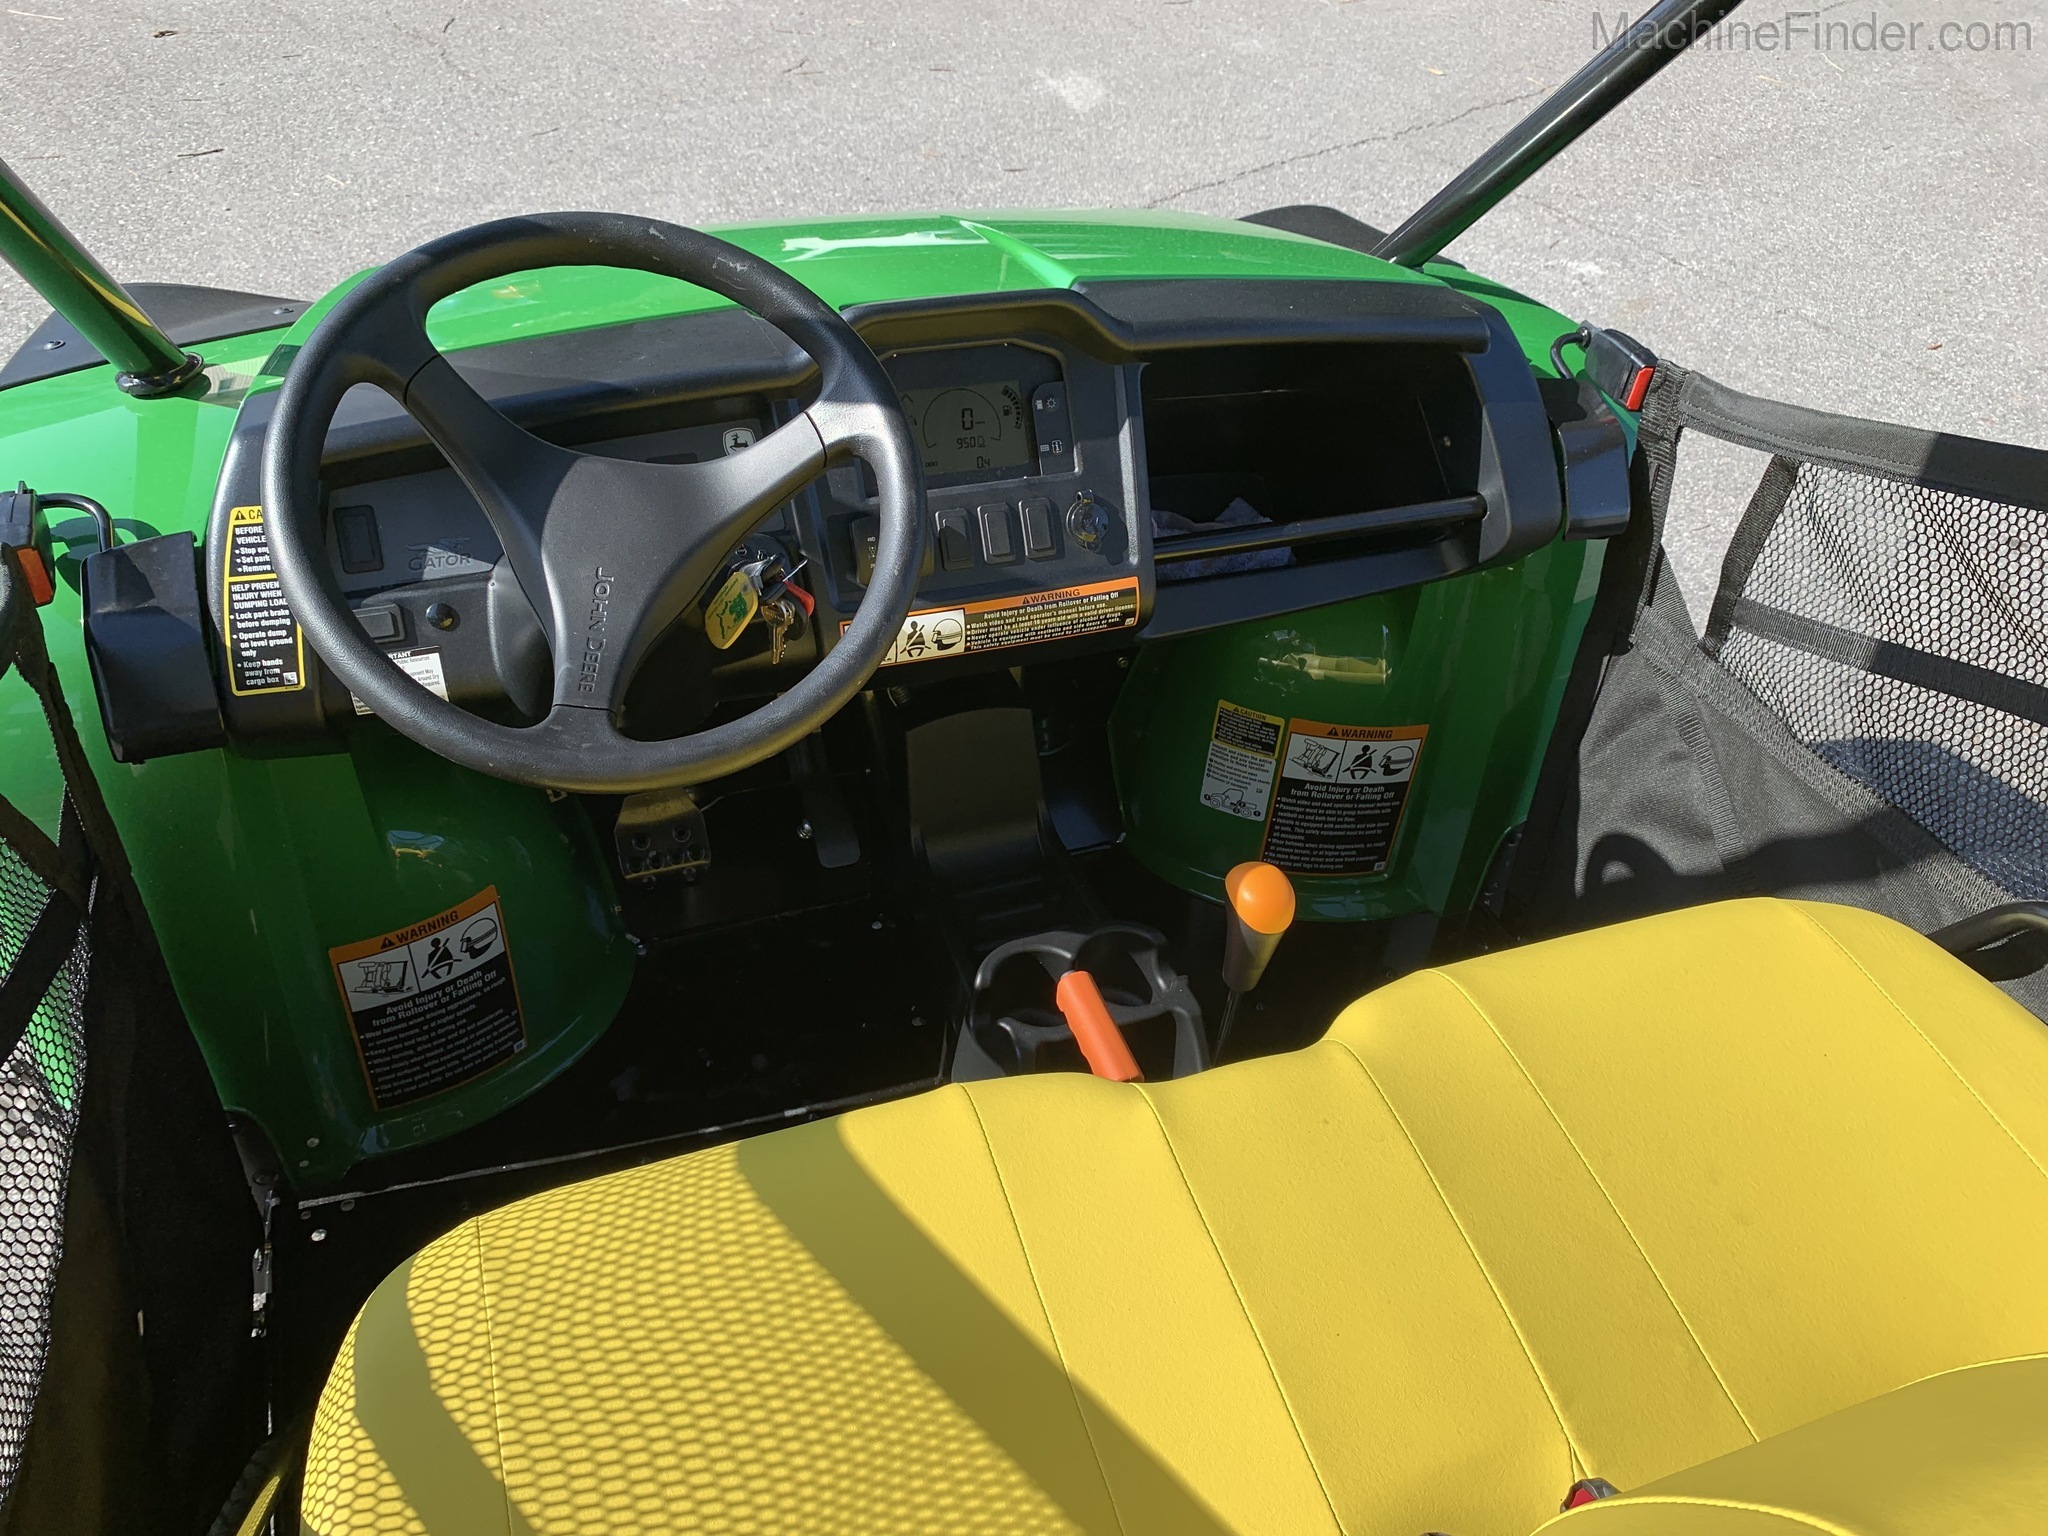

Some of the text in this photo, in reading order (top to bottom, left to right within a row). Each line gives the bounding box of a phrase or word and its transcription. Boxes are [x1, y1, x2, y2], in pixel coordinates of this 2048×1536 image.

[961, 408, 973, 430] 0
[235, 526, 263, 535] BEFORE
[236, 536, 266, 544] VEHICLE
[255, 555, 270, 563] park
[408, 552, 471, 571] GATOR
[252, 582, 279, 590] PREVEN
[233, 590, 282, 601] INJURY WHEN
[1030, 589, 1080, 602] WARNING
[234, 601, 268, 609] DUMPING
[1001, 609, 1018, 617] Injury
[1058, 599, 1081, 607] Rollover
[1090, 594, 1109, 603] Falling
[254, 611, 269, 620] park
[261, 618, 290, 626] dumping
[239, 630, 287, 640] Operate dump
[578, 567, 614, 693] JOHN DEERE
[251, 639, 268, 647] level
[269, 637, 293, 646] ground
[243, 660, 261, 668] Keep
[1240, 708, 1266, 720] CAUTION
[1342, 729, 1393, 739] WARNING
[1304, 783, 1327, 791] Avoid
[1329, 785, 1351, 794] Injury
[1311, 790, 1343, 800] Rollover
[396, 910, 459, 944] WARNING
[386, 1000, 413, 1015] Avoid
[416, 990, 442, 1005] Injury
[456, 971, 482, 988] Death
[372, 970, 497, 1027] from Rollover or Falling Off
